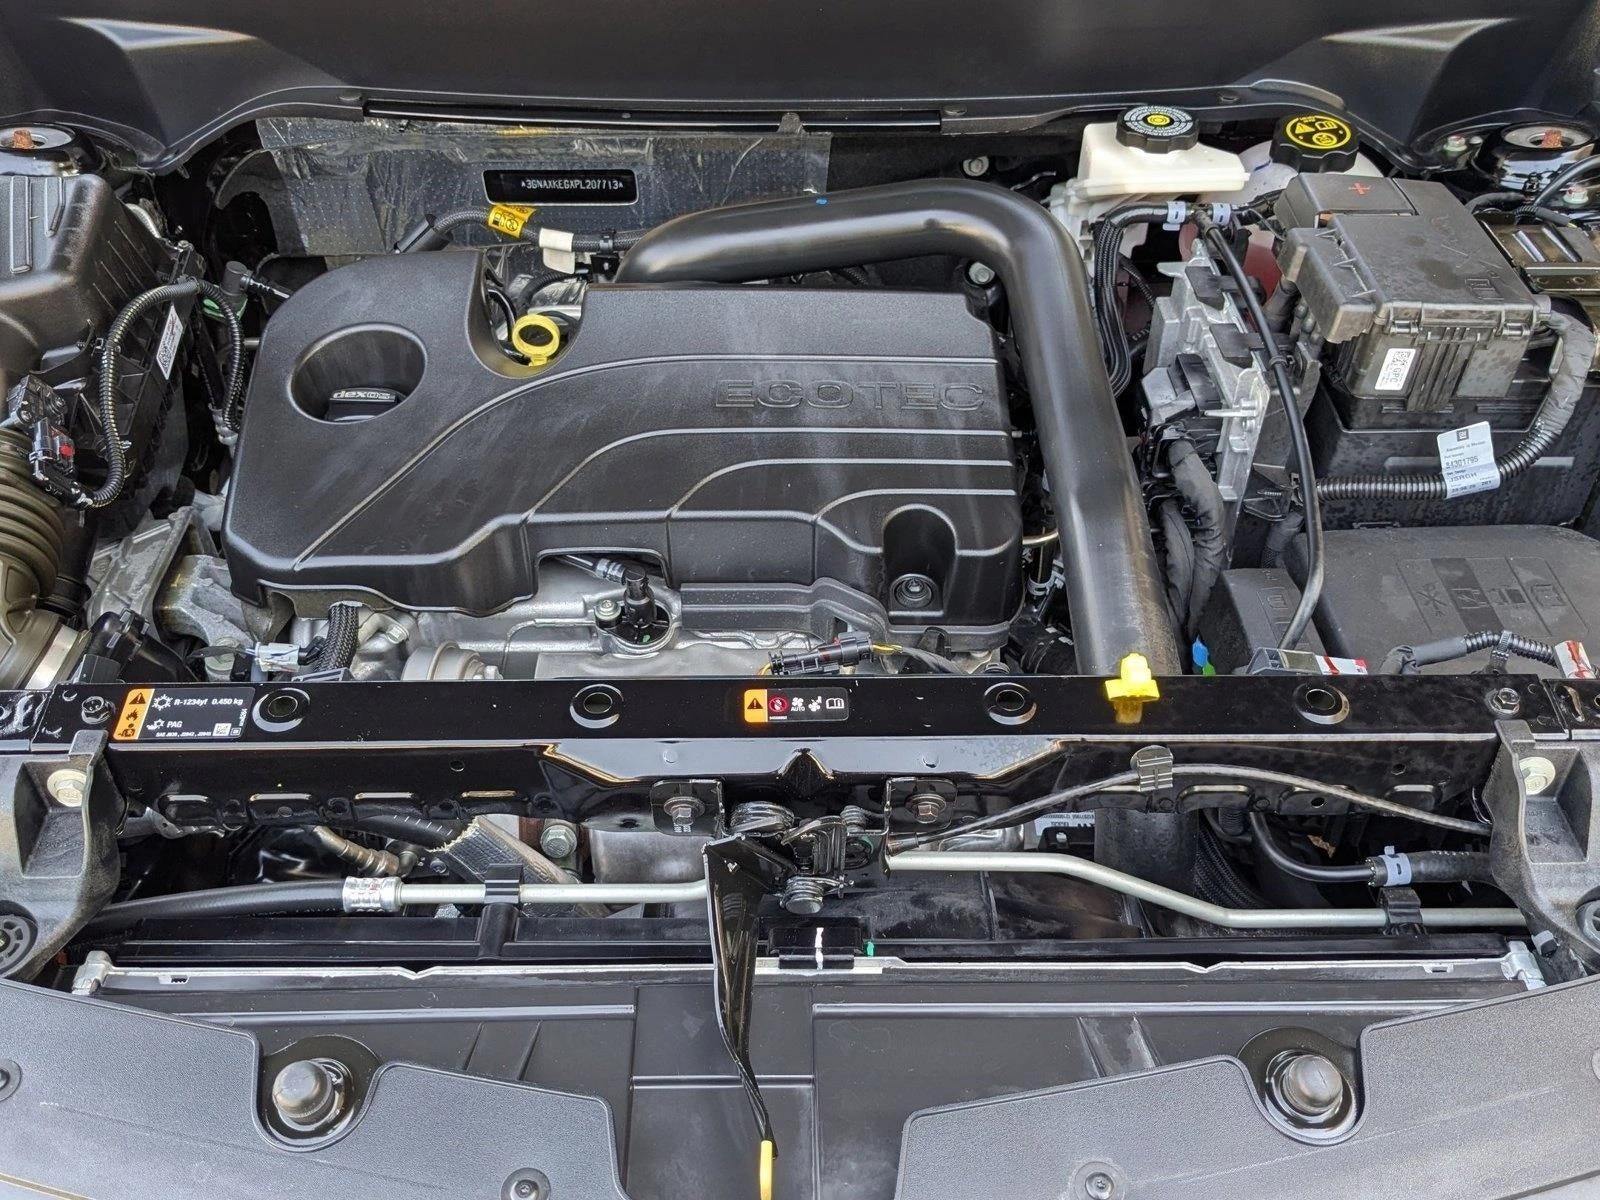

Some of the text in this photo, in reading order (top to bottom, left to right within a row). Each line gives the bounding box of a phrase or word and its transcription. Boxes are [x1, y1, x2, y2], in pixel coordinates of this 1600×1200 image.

[333, 390, 391, 399] dexos
[716, 380, 985, 411] ECOTEC
[174, 698, 243, 706] R-1234yf 0.450 kg
